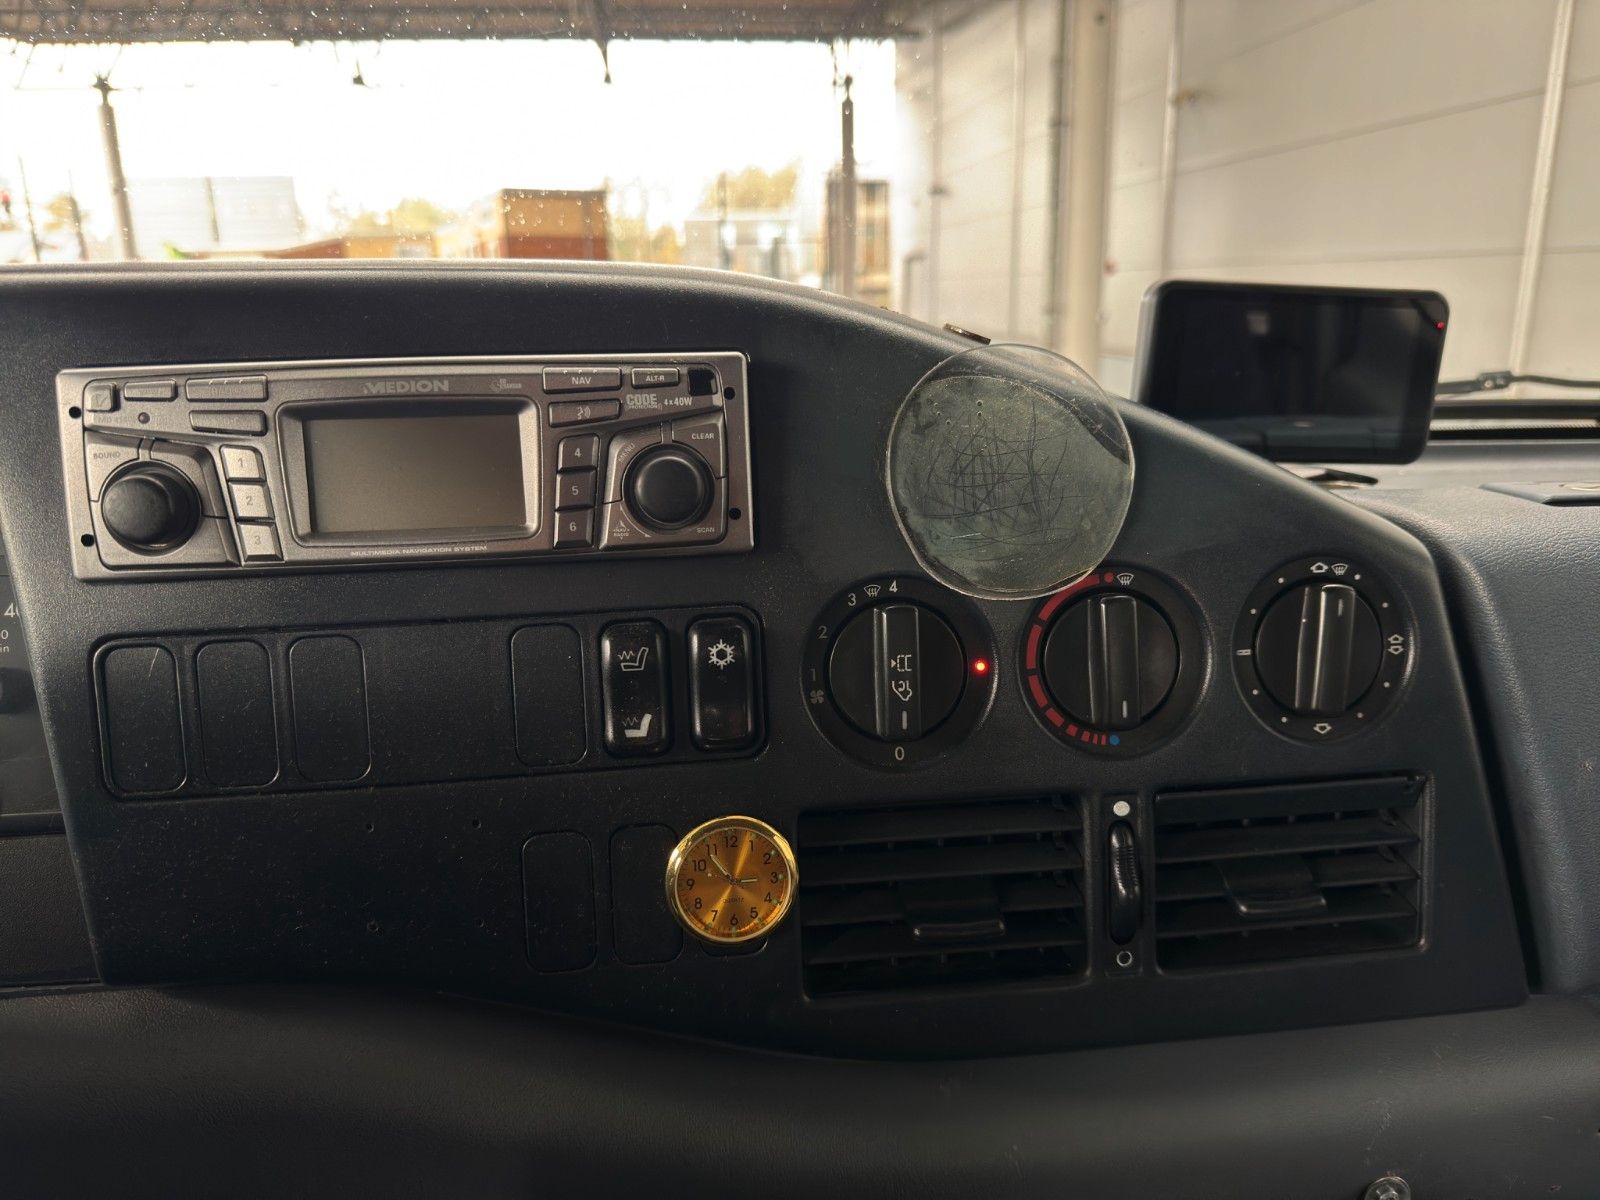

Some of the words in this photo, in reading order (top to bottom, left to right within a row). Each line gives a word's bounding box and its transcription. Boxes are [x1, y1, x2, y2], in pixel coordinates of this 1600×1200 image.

[363, 379, 450, 394] MEDION
[571, 376, 592, 385] NAV
[626, 393, 658, 405] CODE
[663, 396, 693, 406] 4x40W
[691, 432, 715, 440] CLEAR
[92, 451, 121, 460] SOUND
[574, 447, 582, 458] 4
[237, 457, 244, 468] 1
[571, 485, 579, 496] 5
[245, 495, 254, 507] 2
[569, 521, 577, 532] 6
[253, 534, 262, 545] 3
[351, 549, 401, 557] MULTIMEDIA
[402, 547, 452, 555] NAVIGATION
[453, 545, 488, 553] SYSTEM
[888, 580, 898, 593] 4
[847, 593, 857, 606] 3
[817, 625, 828, 639] 2
[809, 668, 816, 681] 1
[894, 746, 905, 761] 0
[724, 836, 738, 848] 12
[749, 840, 754, 852] 1
[706, 844, 718, 856] 11
[763, 852, 771, 864] 2
[692, 860, 707, 872] 10
[770, 871, 778, 884] 3
[686, 879, 695, 890] 9
[694, 897, 703, 909] 8
[763, 892, 772, 904] 4
[711, 910, 718, 922] 7
[750, 907, 758, 919] 5
[730, 914, 739, 926] 6
